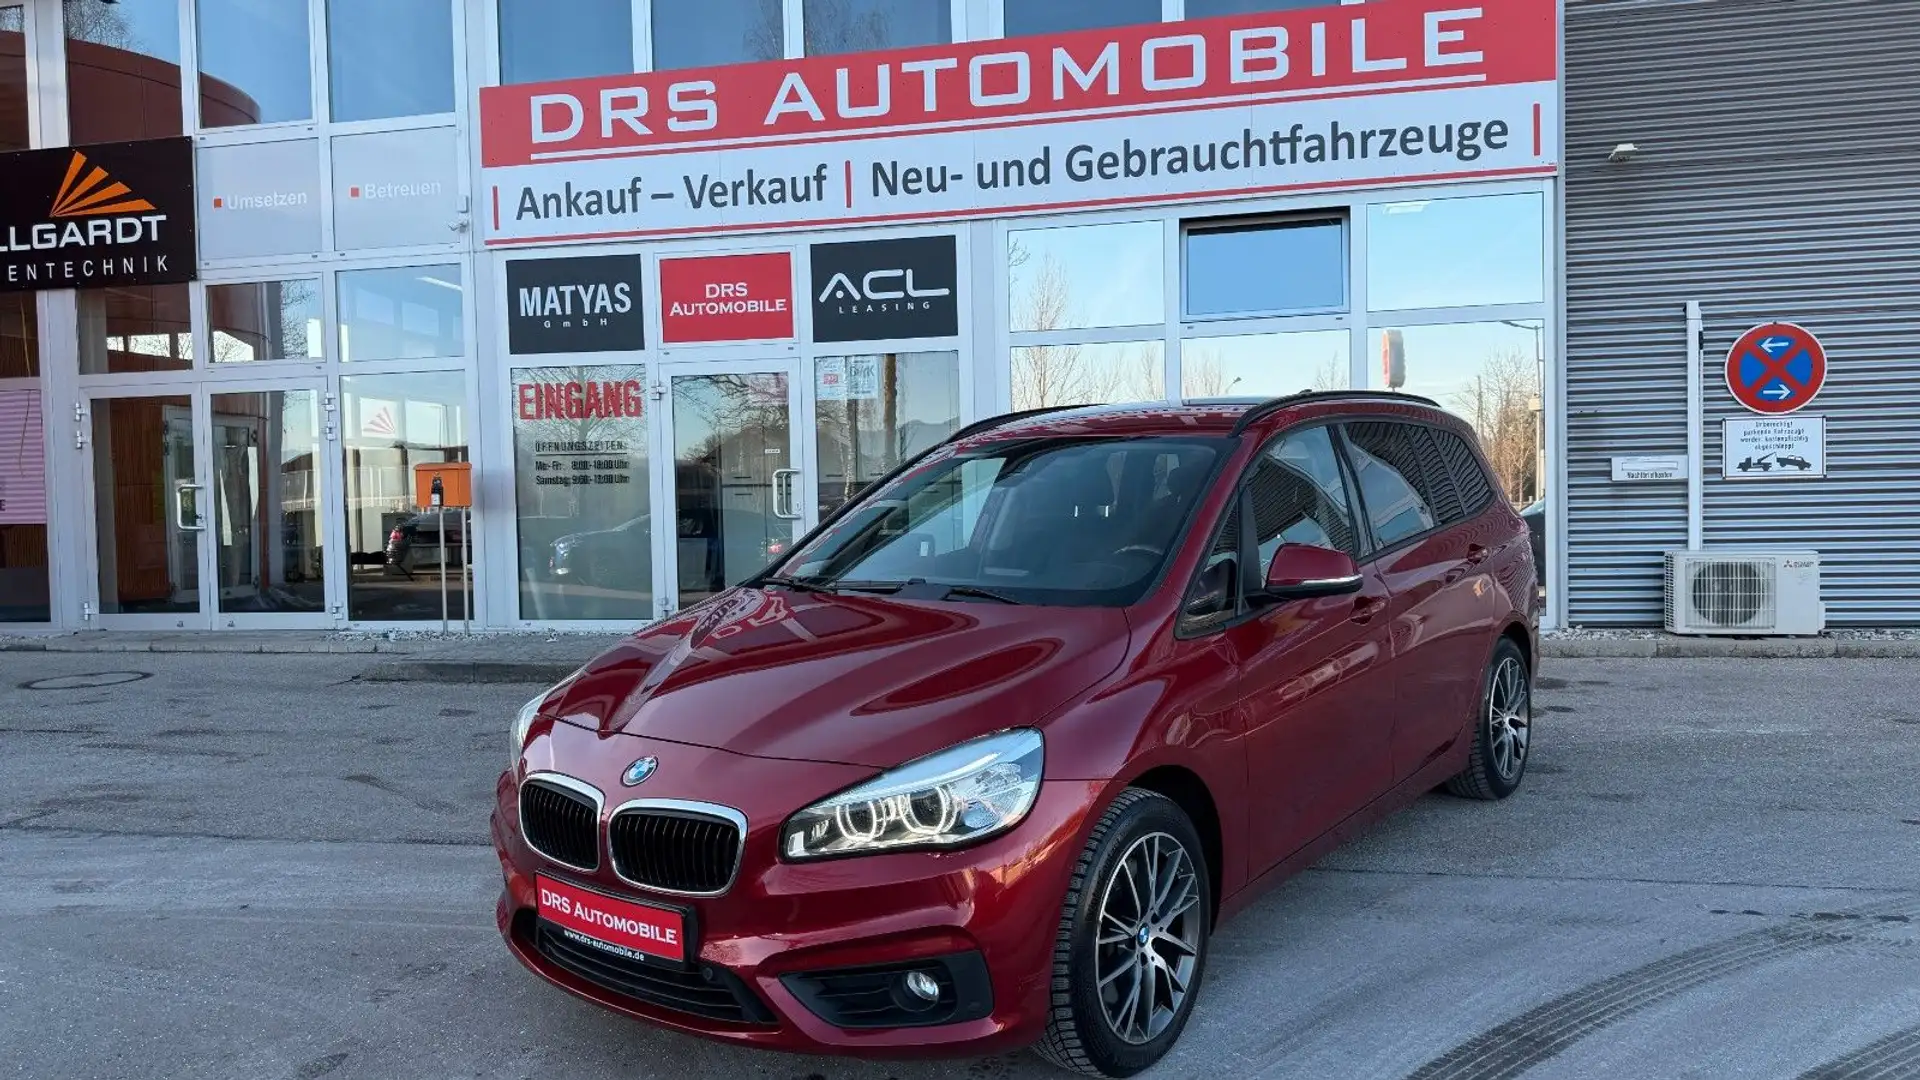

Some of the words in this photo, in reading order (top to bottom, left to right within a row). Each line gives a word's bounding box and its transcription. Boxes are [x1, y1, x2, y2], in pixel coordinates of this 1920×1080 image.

[530, 80, 718, 144] DRS
[764, 7, 1483, 125] AUTOMOBILE
[516, 176, 641, 221] Ankauf
[683, 163, 827, 209] Verkauf
[872, 159, 963, 197] Neu-
[977, 143, 1050, 189] und
[1065, 118, 1509, 181] Gebrauchtfahrzeuge
[227, 190, 307, 210] Umsetzen
[364, 179, 442, 199] Betreuen
[519, 281, 631, 317] MATYAS
[705, 282, 748, 298] DRS
[819, 268, 950, 302] ACL
[669, 299, 787, 317] AUTOMOBILE
[839, 302, 930, 314] LEASING
[518, 380, 642, 420] EINGANG
[541, 888, 571, 914] DRS
[574, 902, 677, 944] AUTOMOBILE
[564, 929, 645, 961] www.drs-automobile.de
